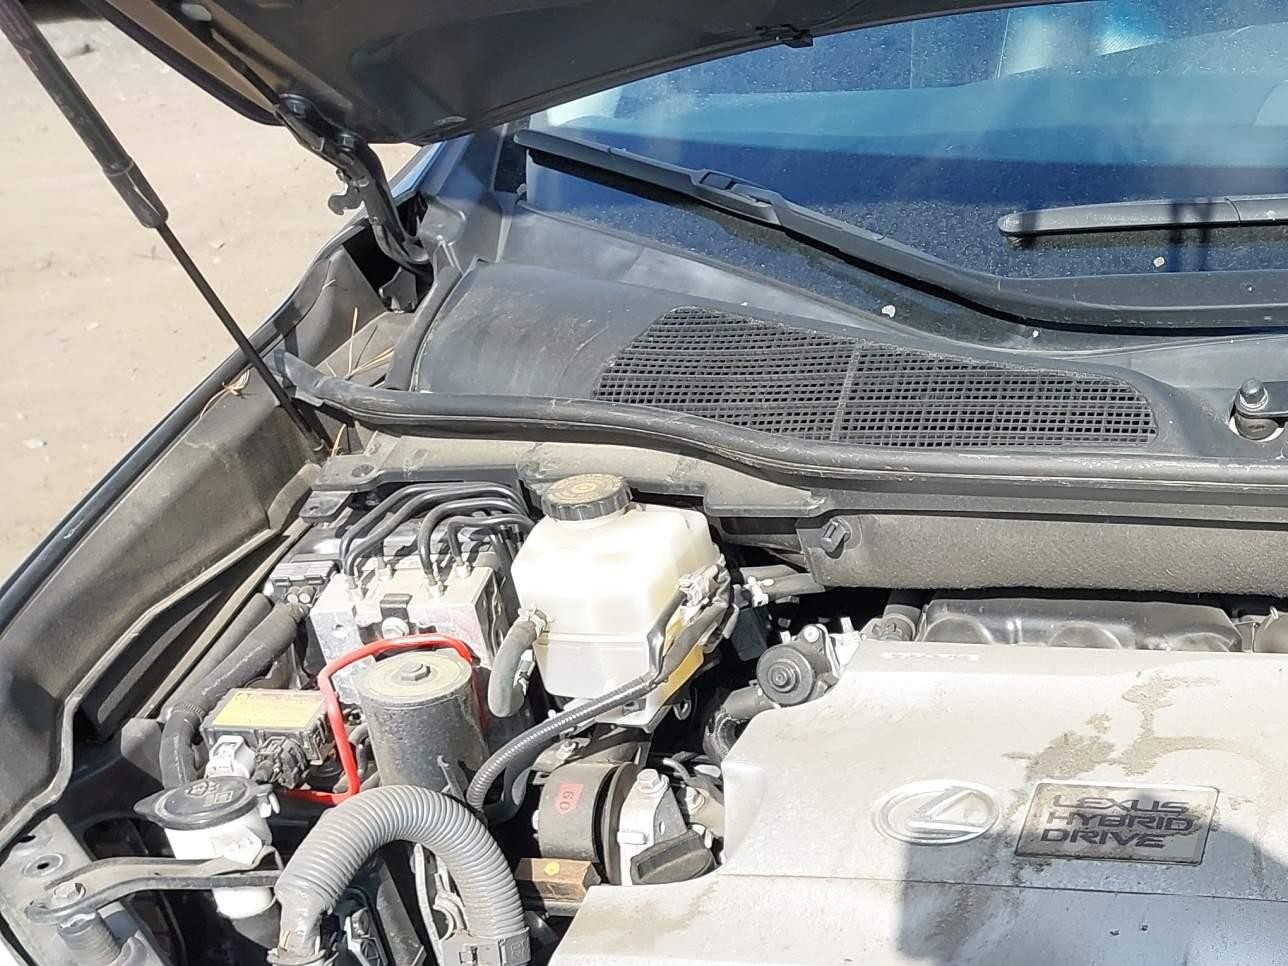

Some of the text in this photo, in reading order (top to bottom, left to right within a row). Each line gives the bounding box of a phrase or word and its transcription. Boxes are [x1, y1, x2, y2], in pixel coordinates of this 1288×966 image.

[1052, 796, 1190, 814] LEXUS
[1045, 811, 1196, 832] HYBRID
[1040, 828, 1166, 849] DRIVE
